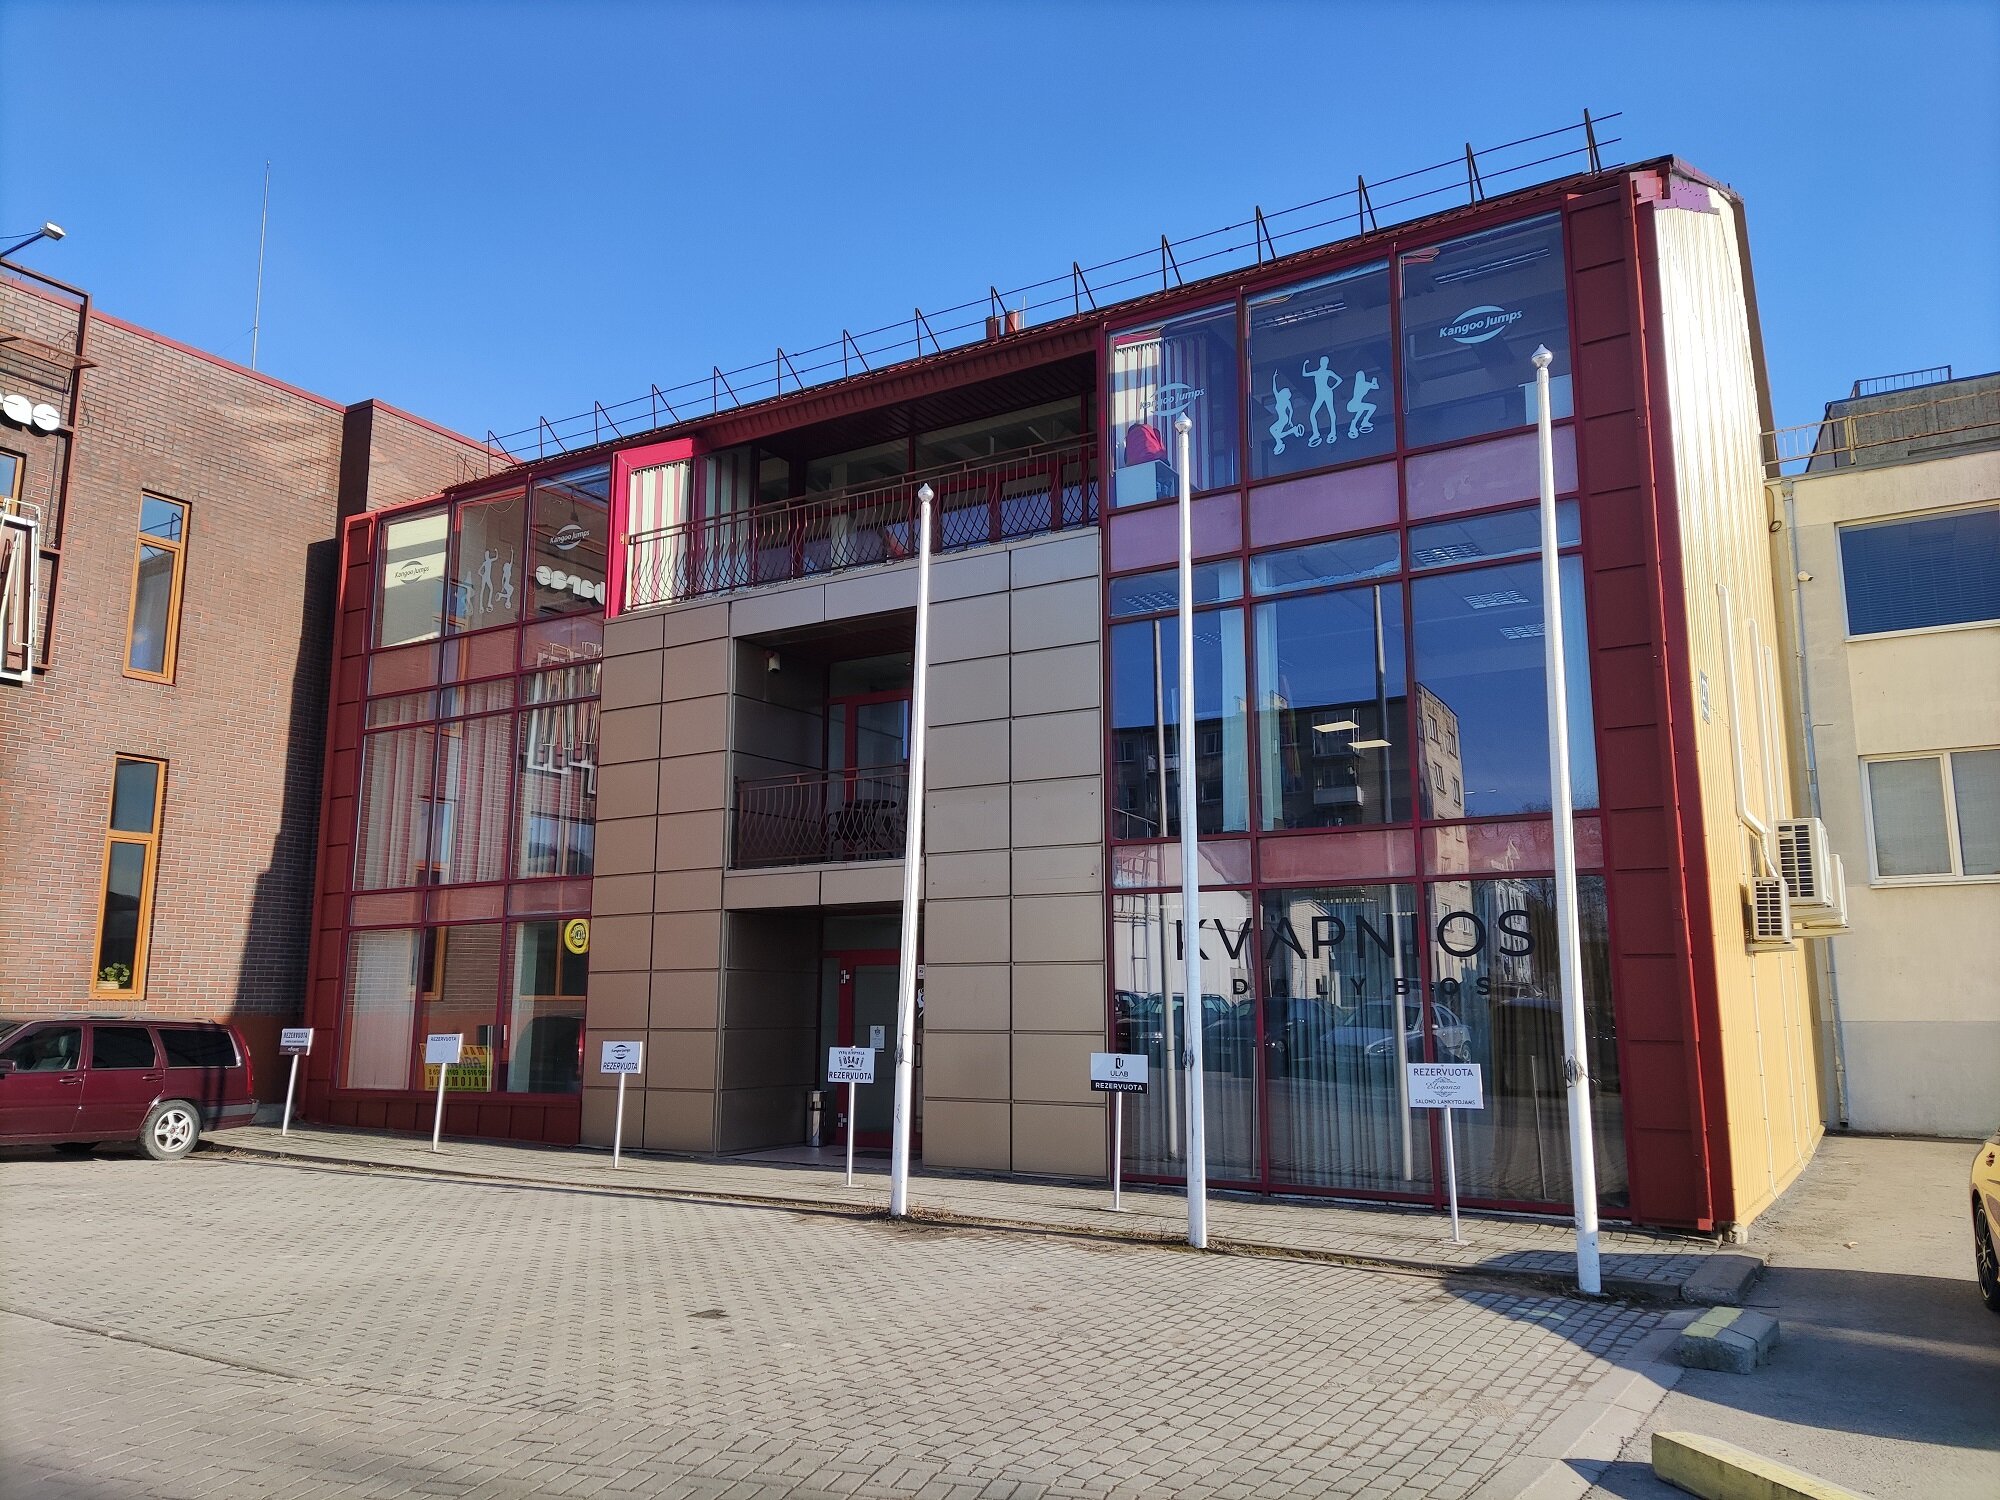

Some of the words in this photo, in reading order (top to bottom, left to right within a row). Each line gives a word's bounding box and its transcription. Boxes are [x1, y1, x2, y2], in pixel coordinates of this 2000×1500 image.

[1440, 319, 1484, 338] Kangoo
[1485, 310, 1523, 329] Jumps
[1175, 388, 1205, 404] Jumps
[550, 535, 571, 544] Kangoo
[571, 529, 590, 541] Jumps
[394, 569, 414, 579] Kangoo
[1176, 910, 1535, 961] KVAPNIOS
[1232, 976, 1492, 995] DALYBOS
[603, 1062, 638, 1071] REZERVUOTA
[828, 1071, 872, 1081] REZERVUOTA
[1110, 1070, 1129, 1078] ULAB
[1413, 1067, 1474, 1077] REZERVUOTA
[1095, 1082, 1144, 1091] REZERVUOTA
